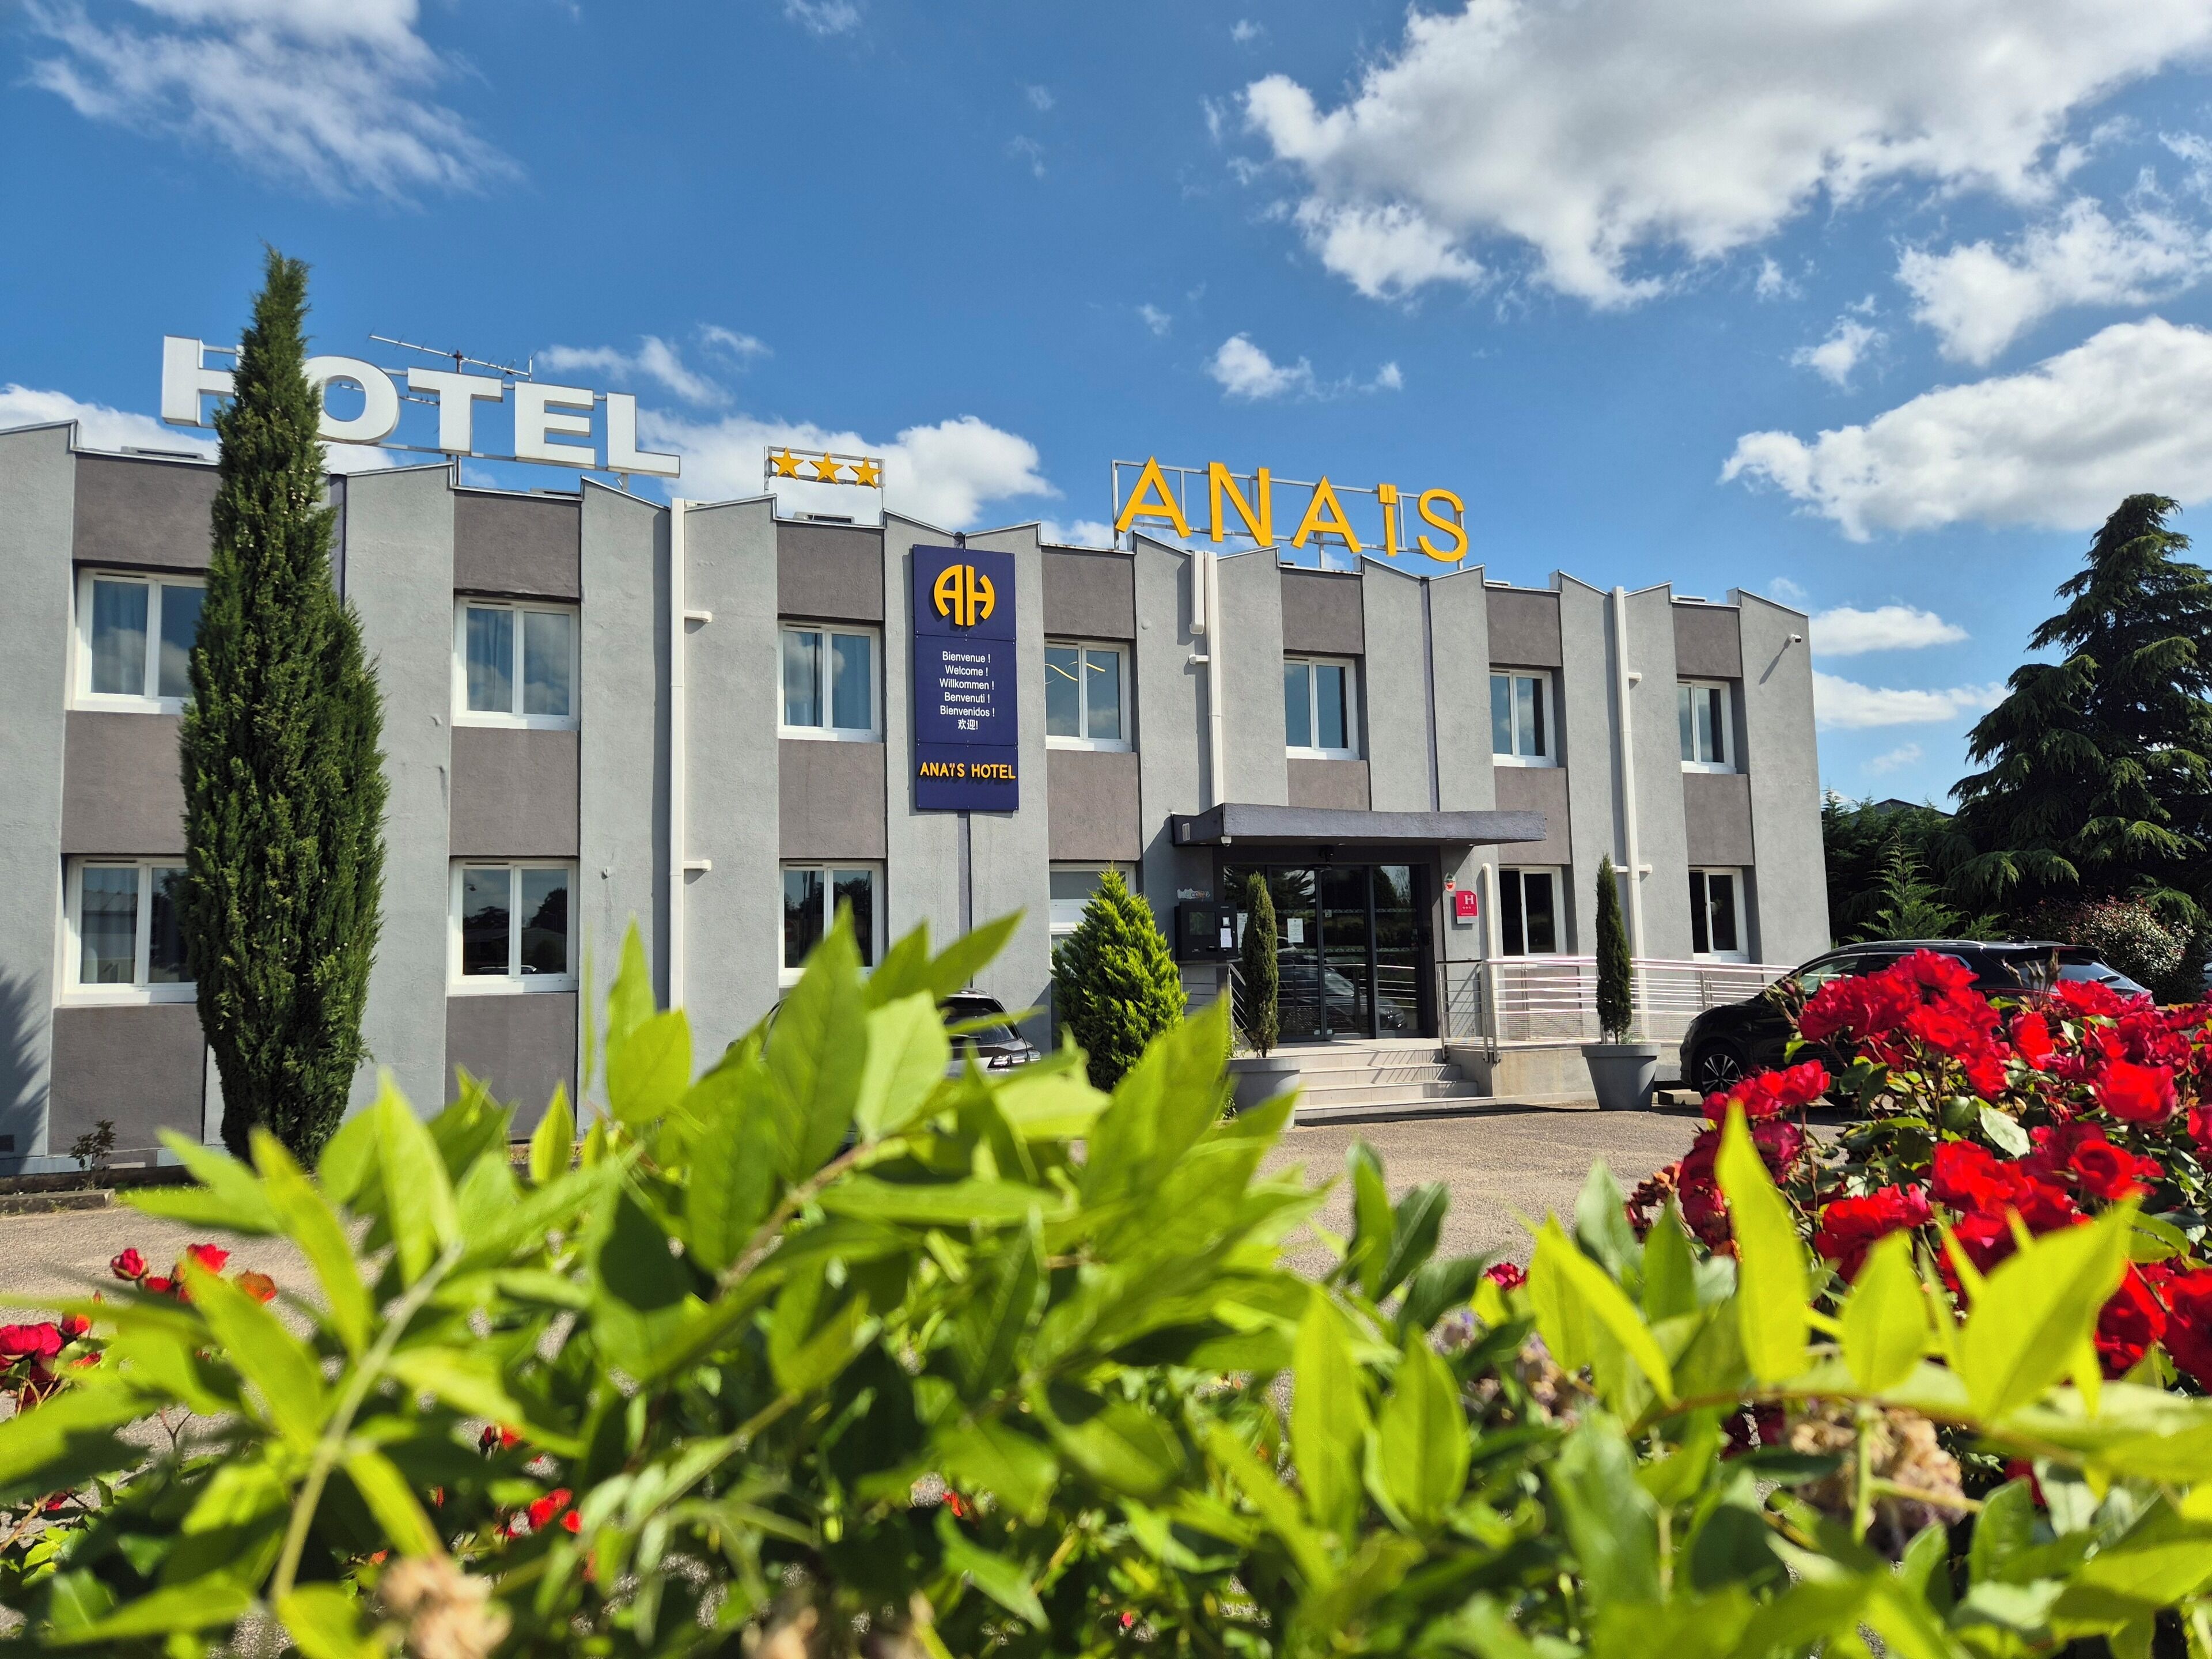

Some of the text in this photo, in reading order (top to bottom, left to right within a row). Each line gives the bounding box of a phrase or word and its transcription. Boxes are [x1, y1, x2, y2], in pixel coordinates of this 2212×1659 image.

[942, 651, 986, 663] Bienvenue
[945, 664, 983, 676] Welcome
[939, 678, 989, 690] Willkommen
[945, 692, 985, 703] Benvenuti
[940, 705, 990, 717] Bienvenidos
[971, 763, 1016, 779] HOTEL
[1464, 895, 1475, 905] H
